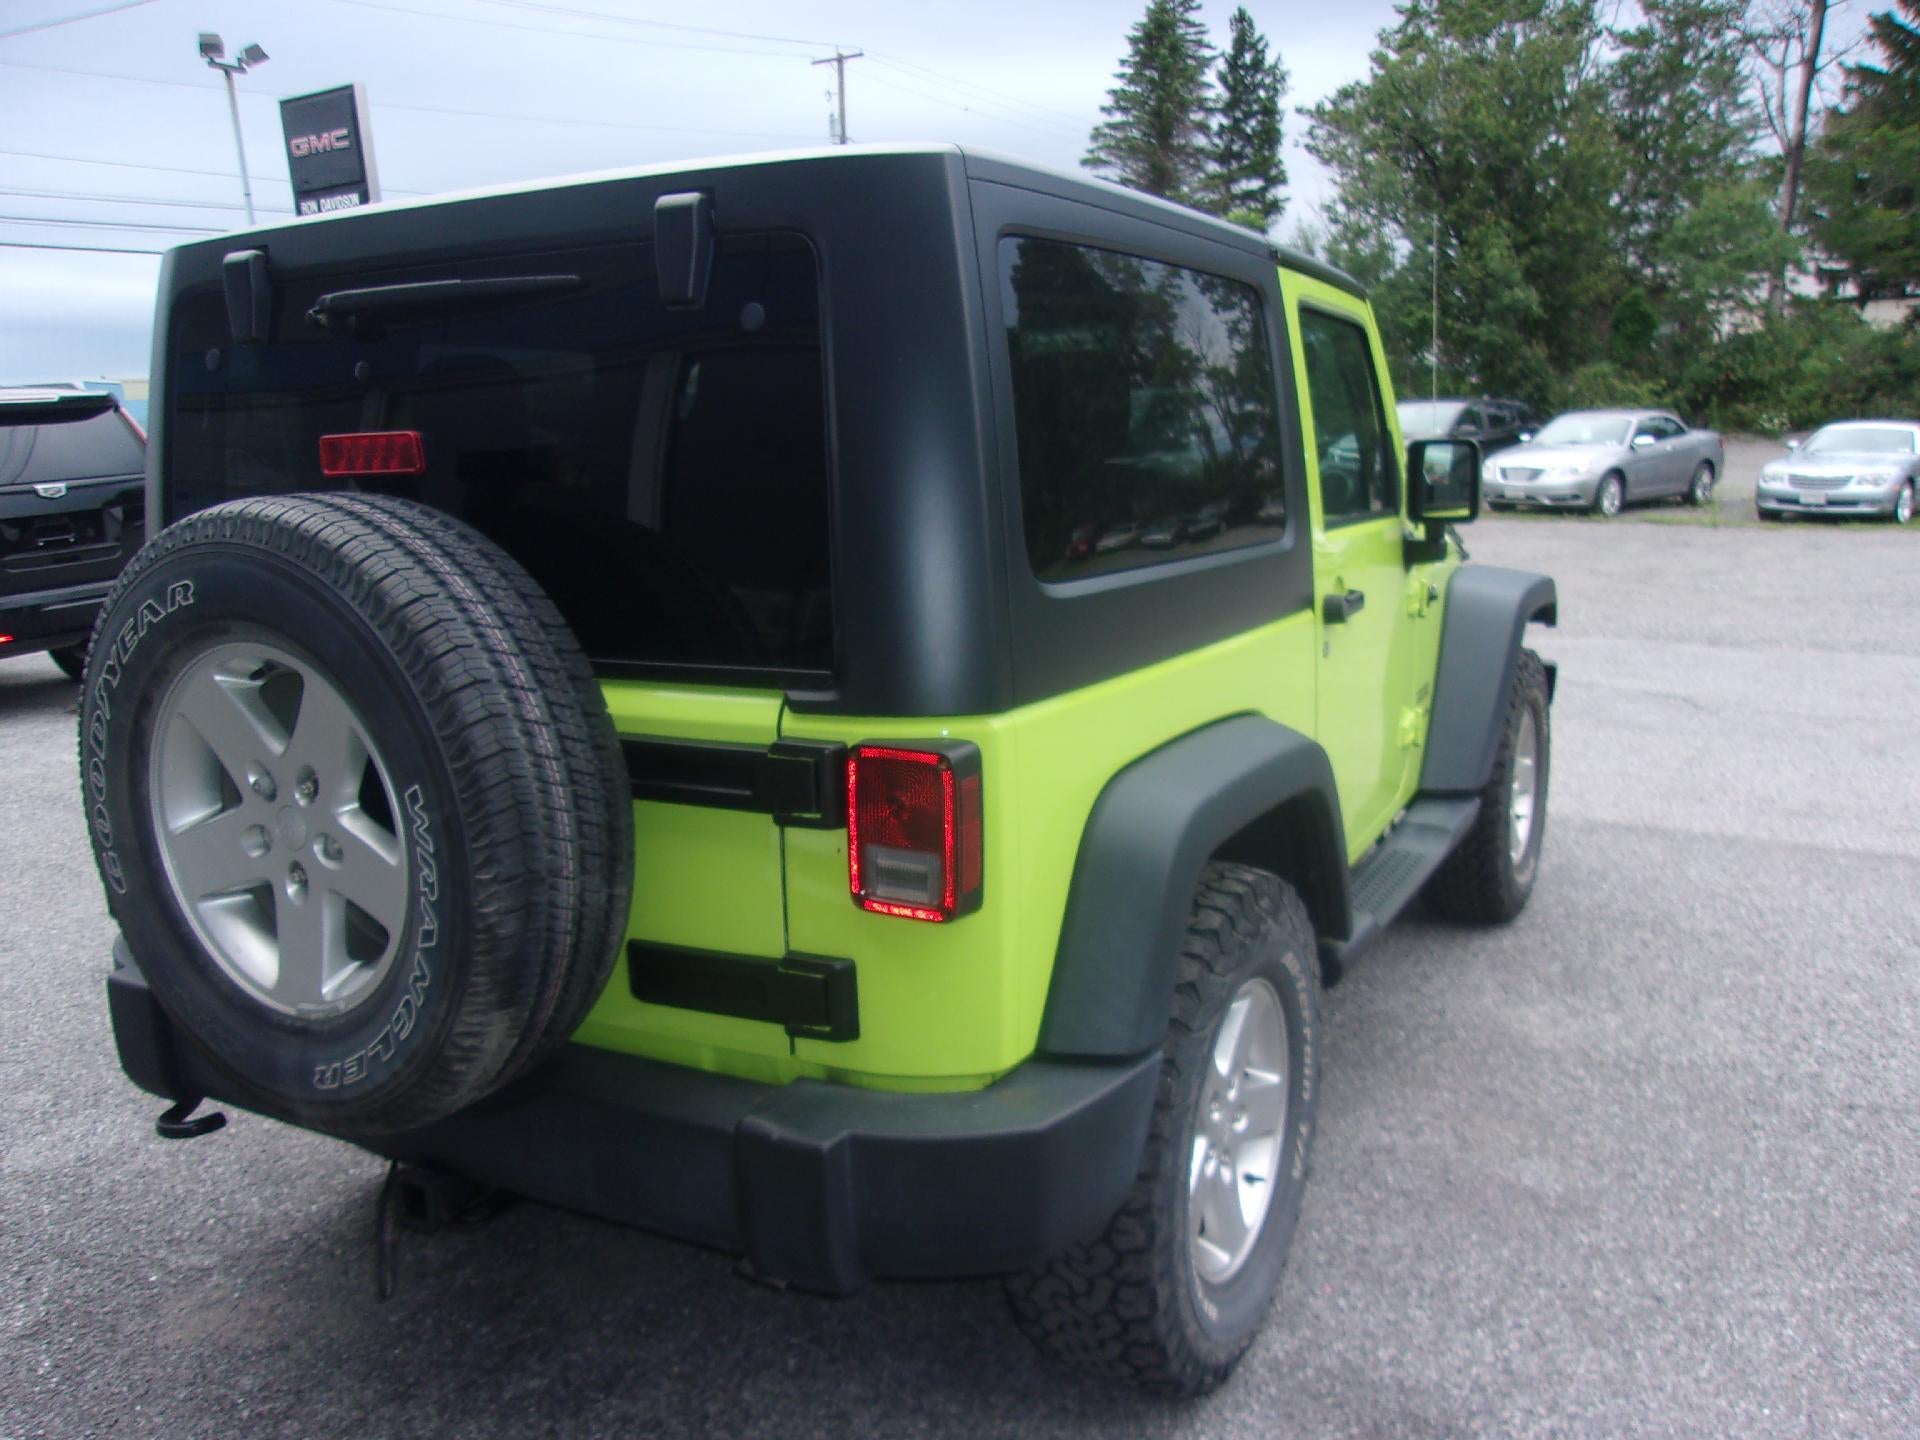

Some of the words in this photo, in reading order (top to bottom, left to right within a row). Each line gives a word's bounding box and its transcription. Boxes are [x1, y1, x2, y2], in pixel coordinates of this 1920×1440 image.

[291, 129, 349, 157] GMC
[301, 202, 318, 215] RON
[321, 194, 360, 212] DAVIDSON
[91, 579, 196, 894] GOODYEAR
[313, 784, 438, 1090] WRANGLER
